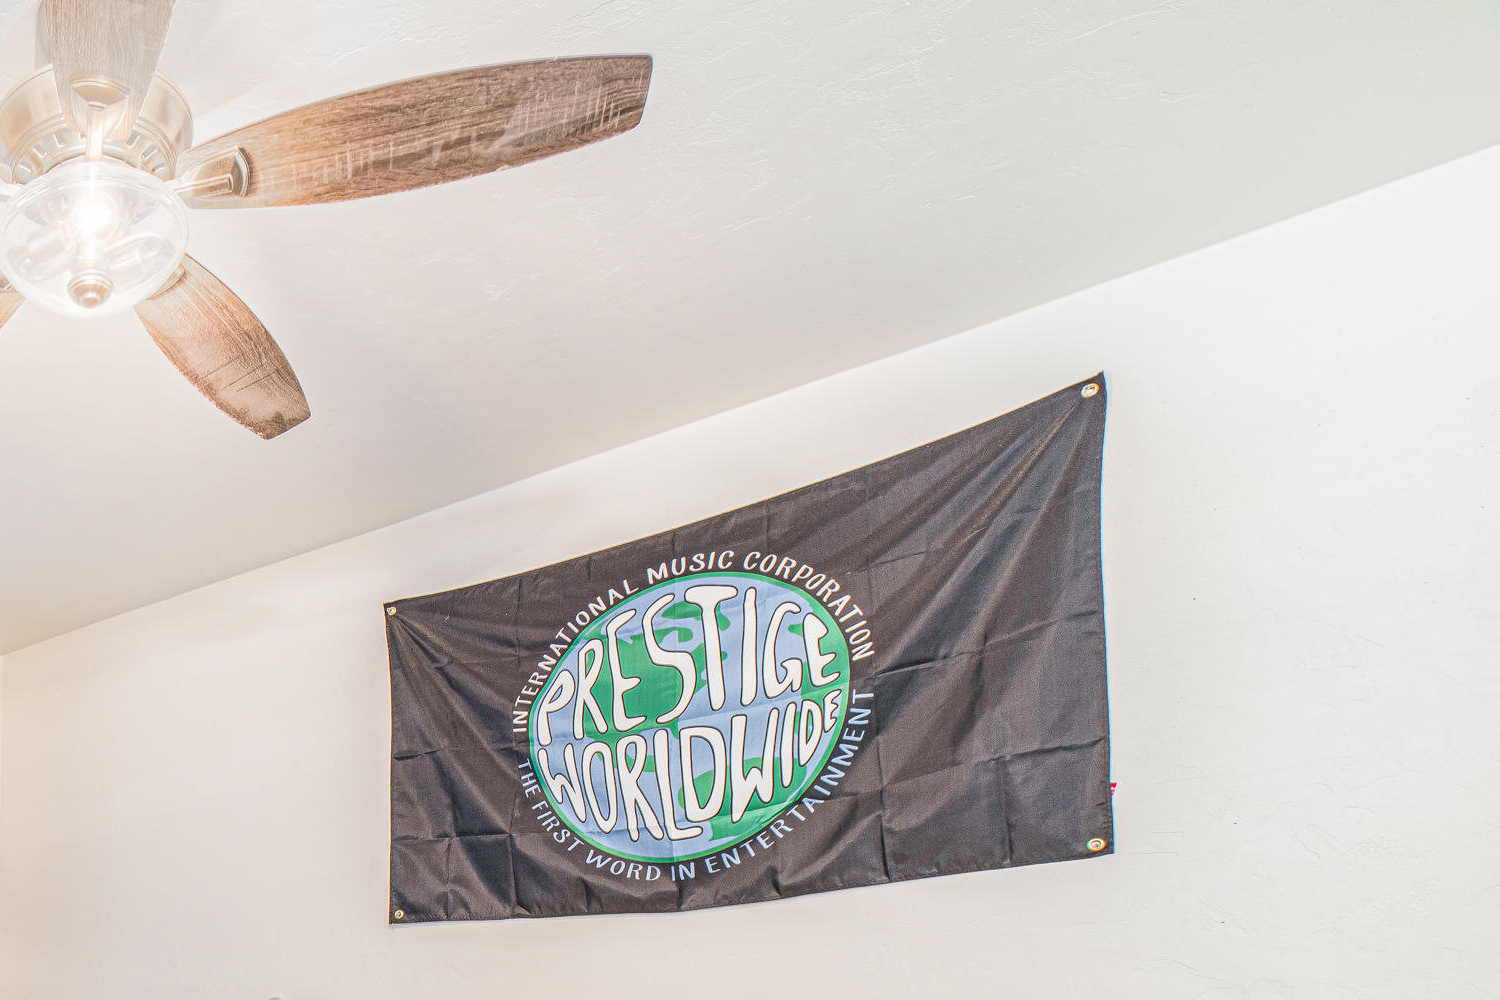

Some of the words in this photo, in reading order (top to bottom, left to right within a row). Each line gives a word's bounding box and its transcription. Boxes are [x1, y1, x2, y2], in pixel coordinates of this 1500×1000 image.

[512, 579, 640, 734] INTERNATIONAL
[646, 549, 736, 585] MUSIC
[743, 550, 875, 662] CORPORATION
[536, 584, 841, 747] PRESTIGE
[516, 758, 542, 798] THE
[531, 801, 585, 854] FIRST
[585, 847, 662, 882] WORD
[671, 863, 696, 882] IN
[705, 687, 875, 874] ENTERTAINMENT
[537, 688, 842, 843] WORLDWIDE
